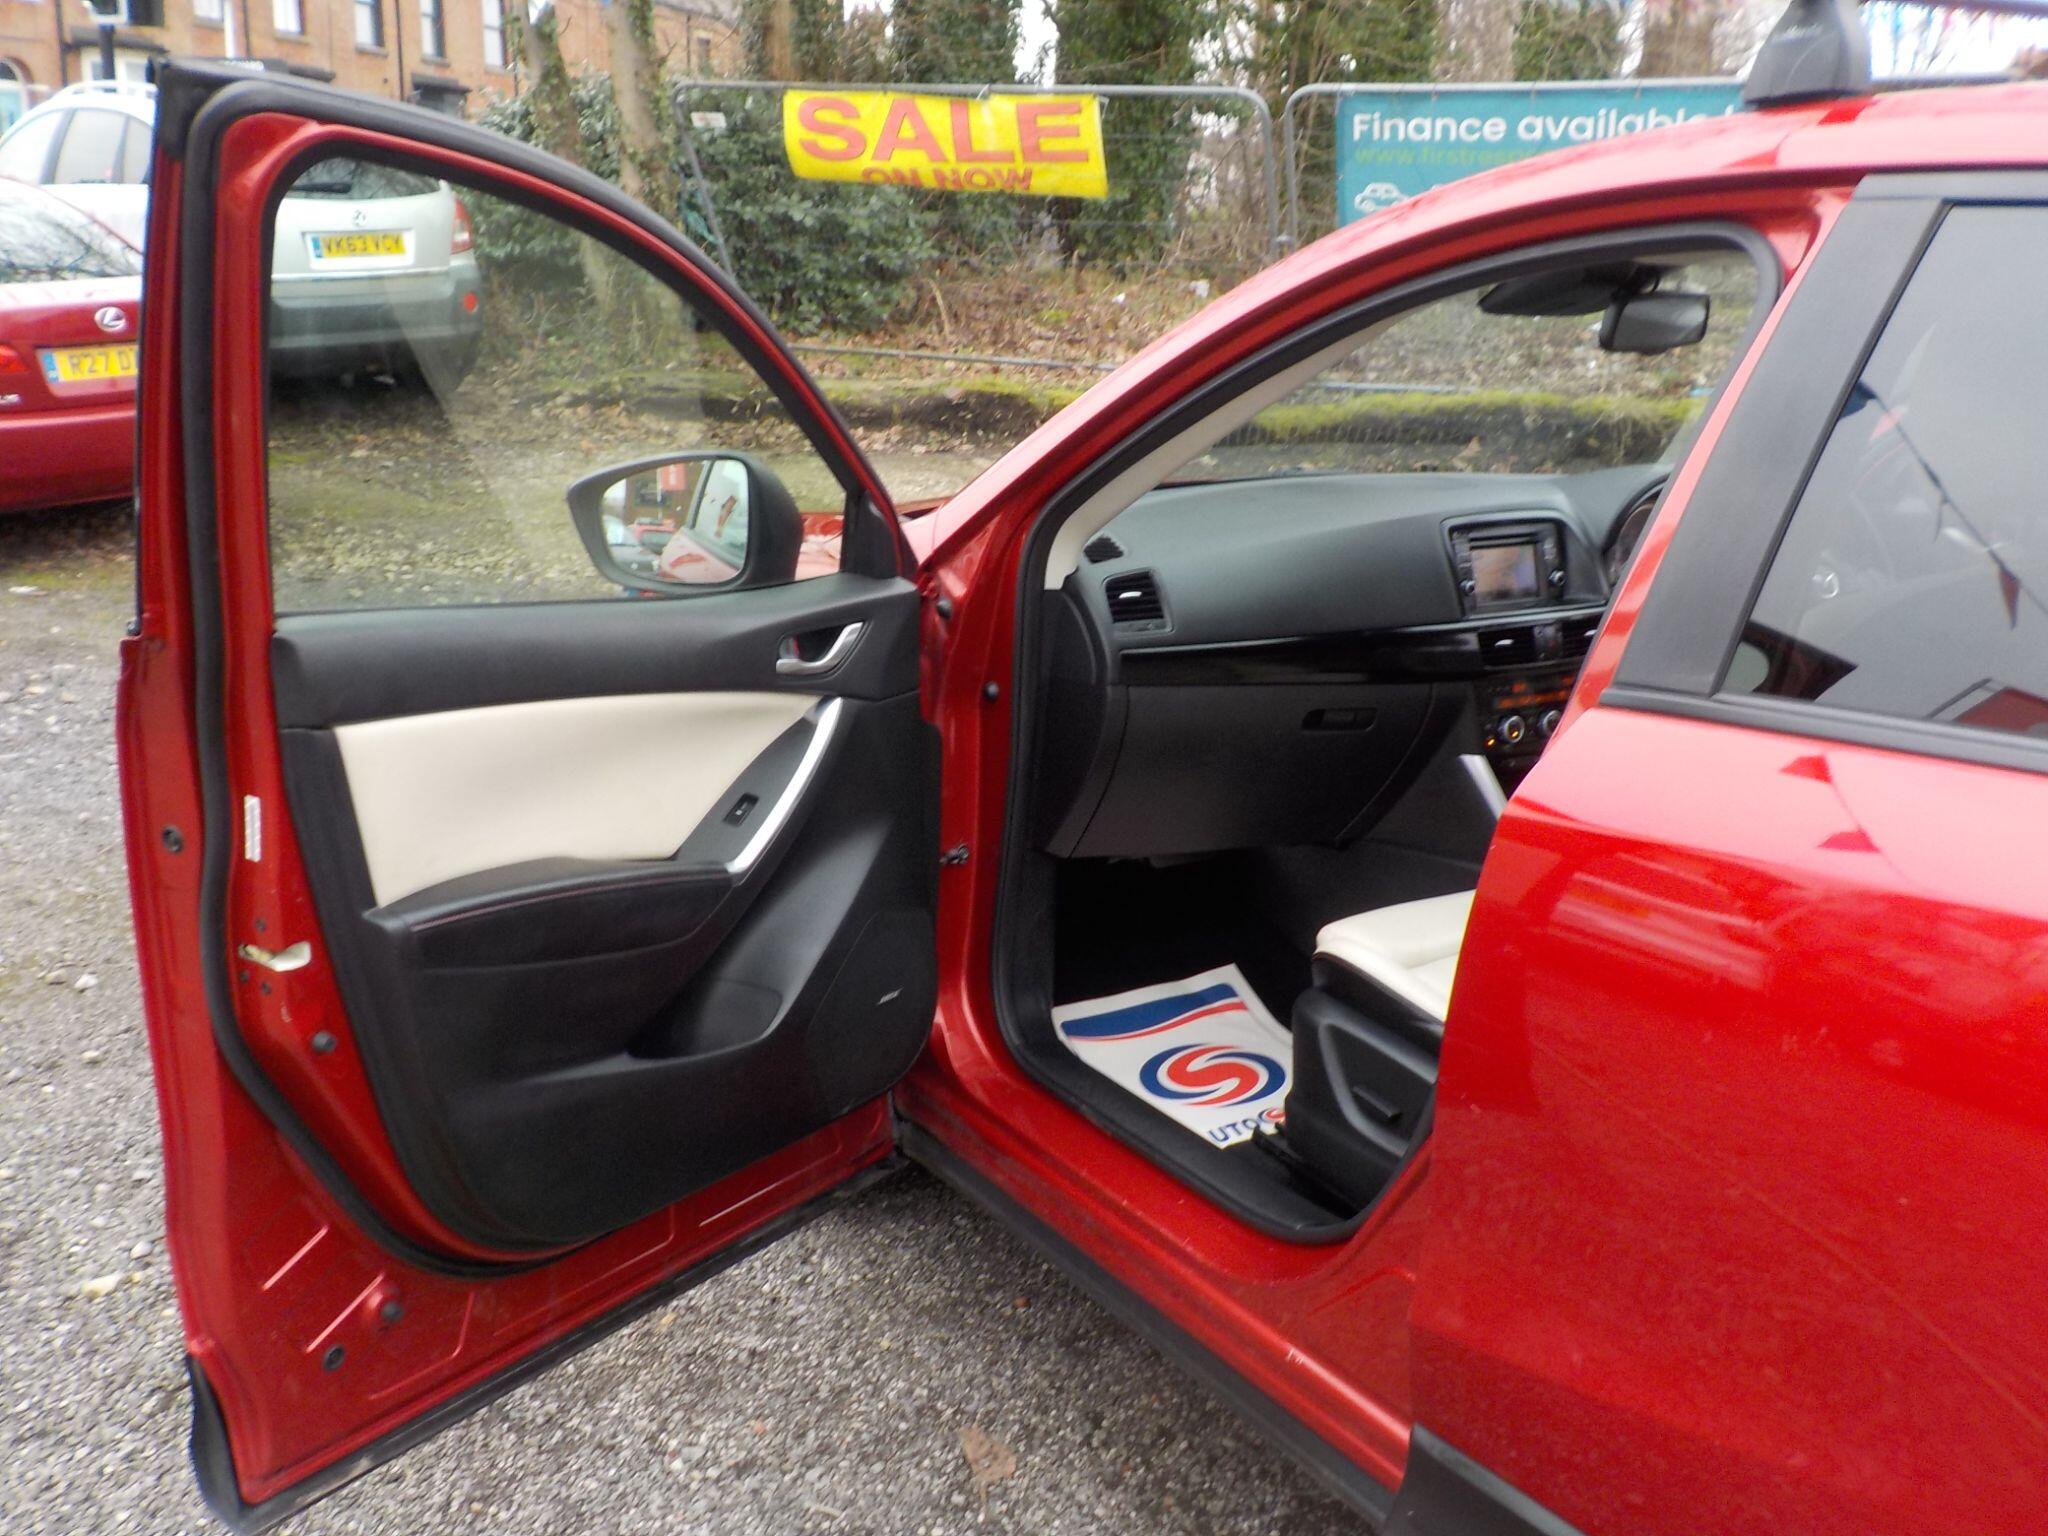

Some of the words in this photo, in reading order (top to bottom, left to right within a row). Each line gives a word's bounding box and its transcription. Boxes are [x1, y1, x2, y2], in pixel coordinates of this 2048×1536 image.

[797, 96, 1090, 163] SALE
[1352, 111, 1507, 143] Finance
[861, 165, 923, 188] ON
[931, 167, 1032, 191] NOW
